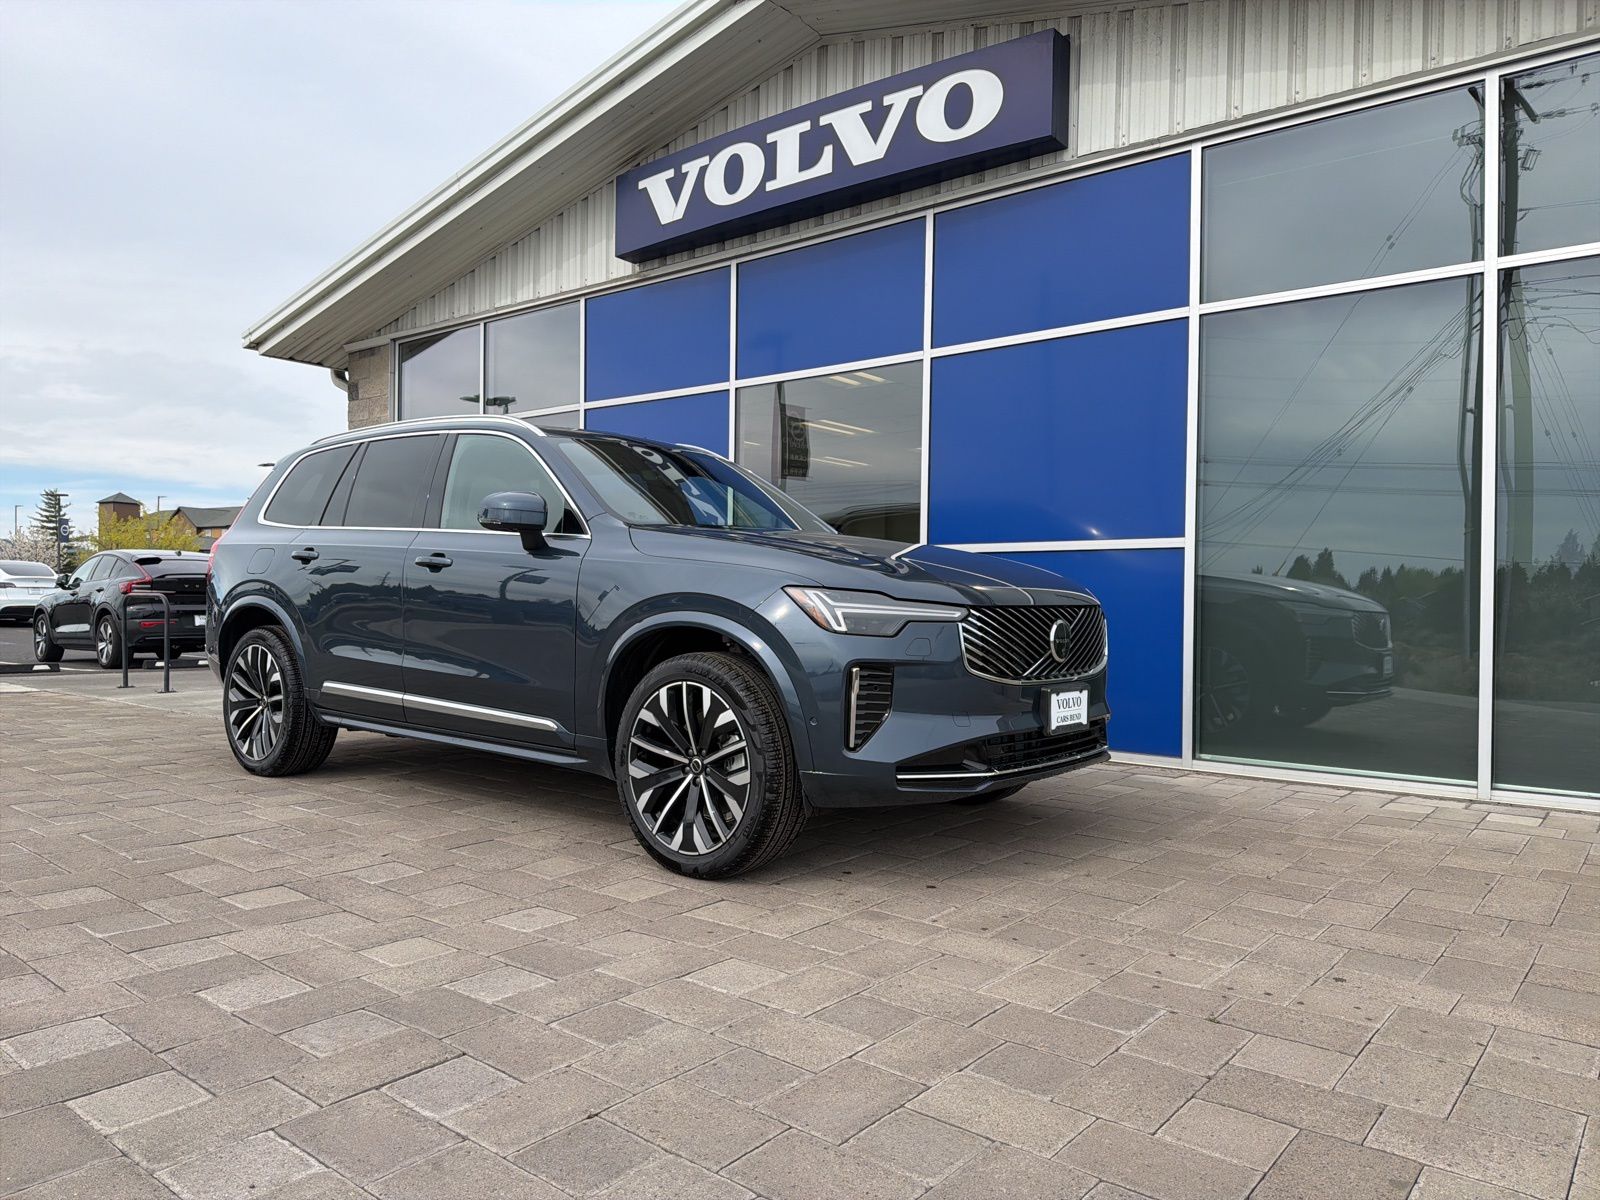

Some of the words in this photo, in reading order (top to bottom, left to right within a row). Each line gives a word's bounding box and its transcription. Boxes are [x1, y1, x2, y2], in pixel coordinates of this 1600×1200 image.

[638, 69, 1004, 225] VOLVO
[1056, 696, 1082, 710] VOLVO
[1056, 714, 1069, 723] CARS
[1070, 712, 1082, 721] BEND
